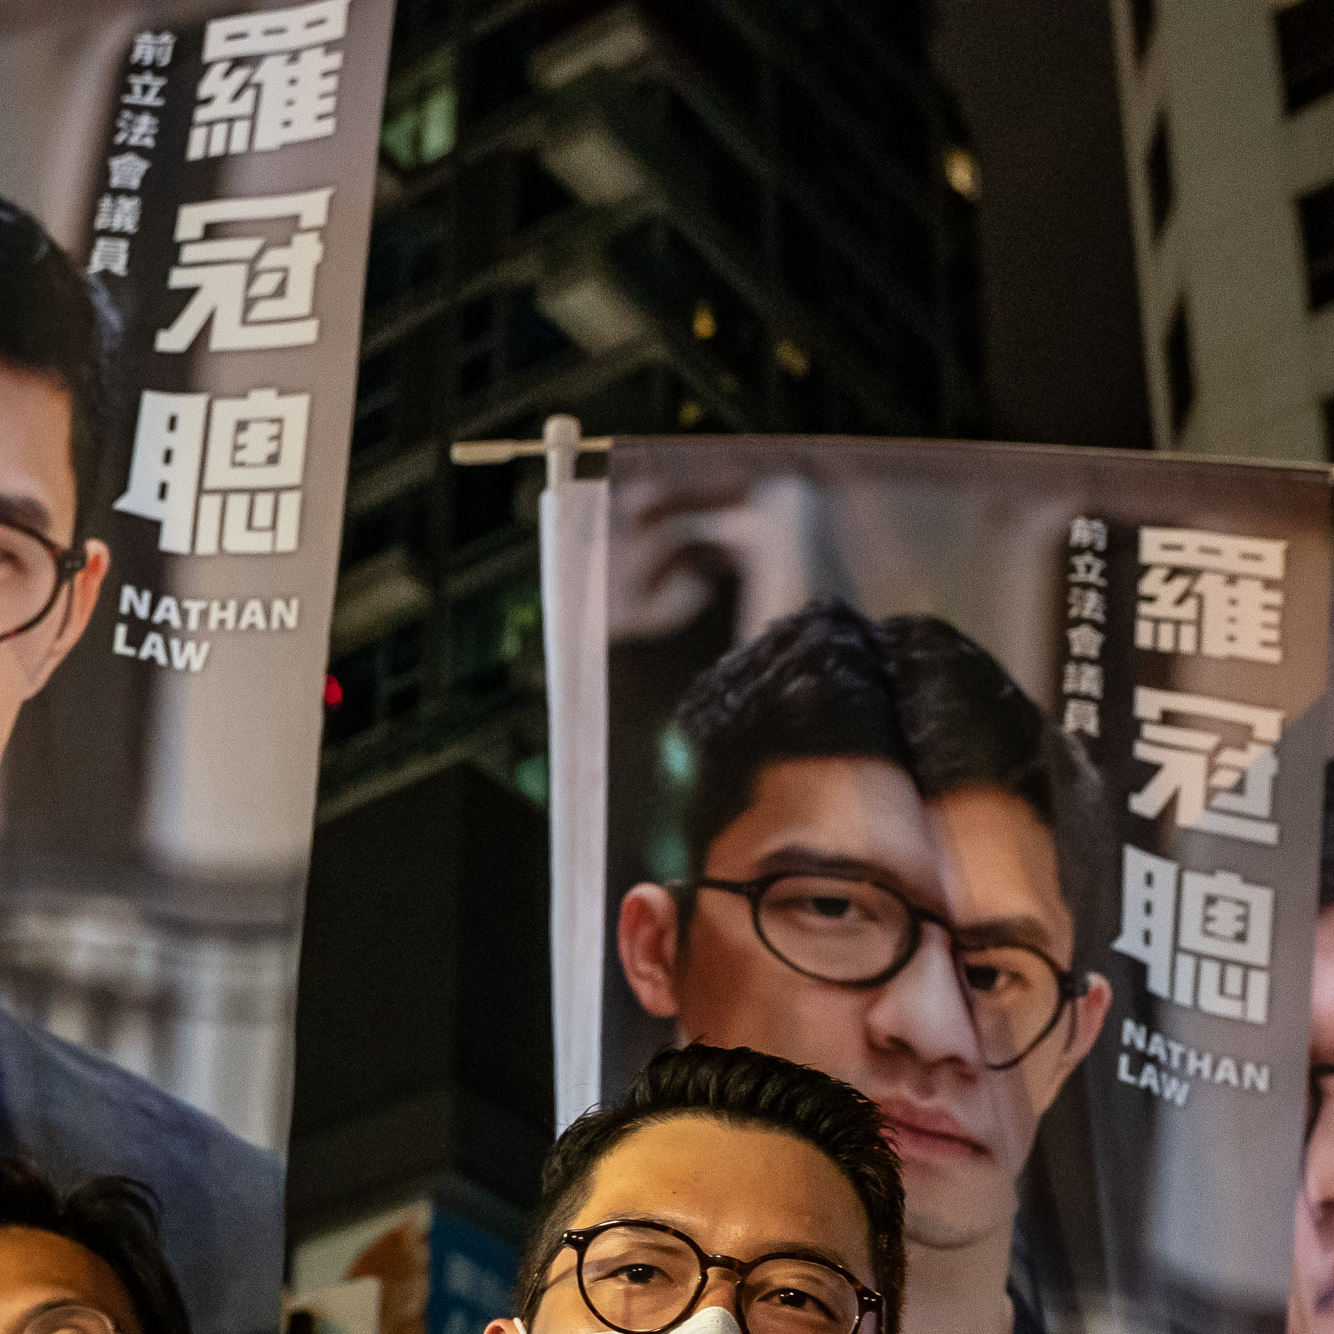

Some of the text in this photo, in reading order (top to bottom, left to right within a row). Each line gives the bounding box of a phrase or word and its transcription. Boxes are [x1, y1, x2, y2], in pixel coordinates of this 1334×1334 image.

[87, 31, 175, 278] 前立法會議員
[113, 0, 349, 556] 羅冠聰
[113, 624, 210, 672] LAW
[119, 585, 299, 631] NATHAN
[1063, 516, 1108, 739] 前立法會議員
[1112, 525, 1289, 1025] 羅冠聰
[1118, 1052, 1193, 1106] LAW
[1121, 1018, 1270, 1092] NATHAN
